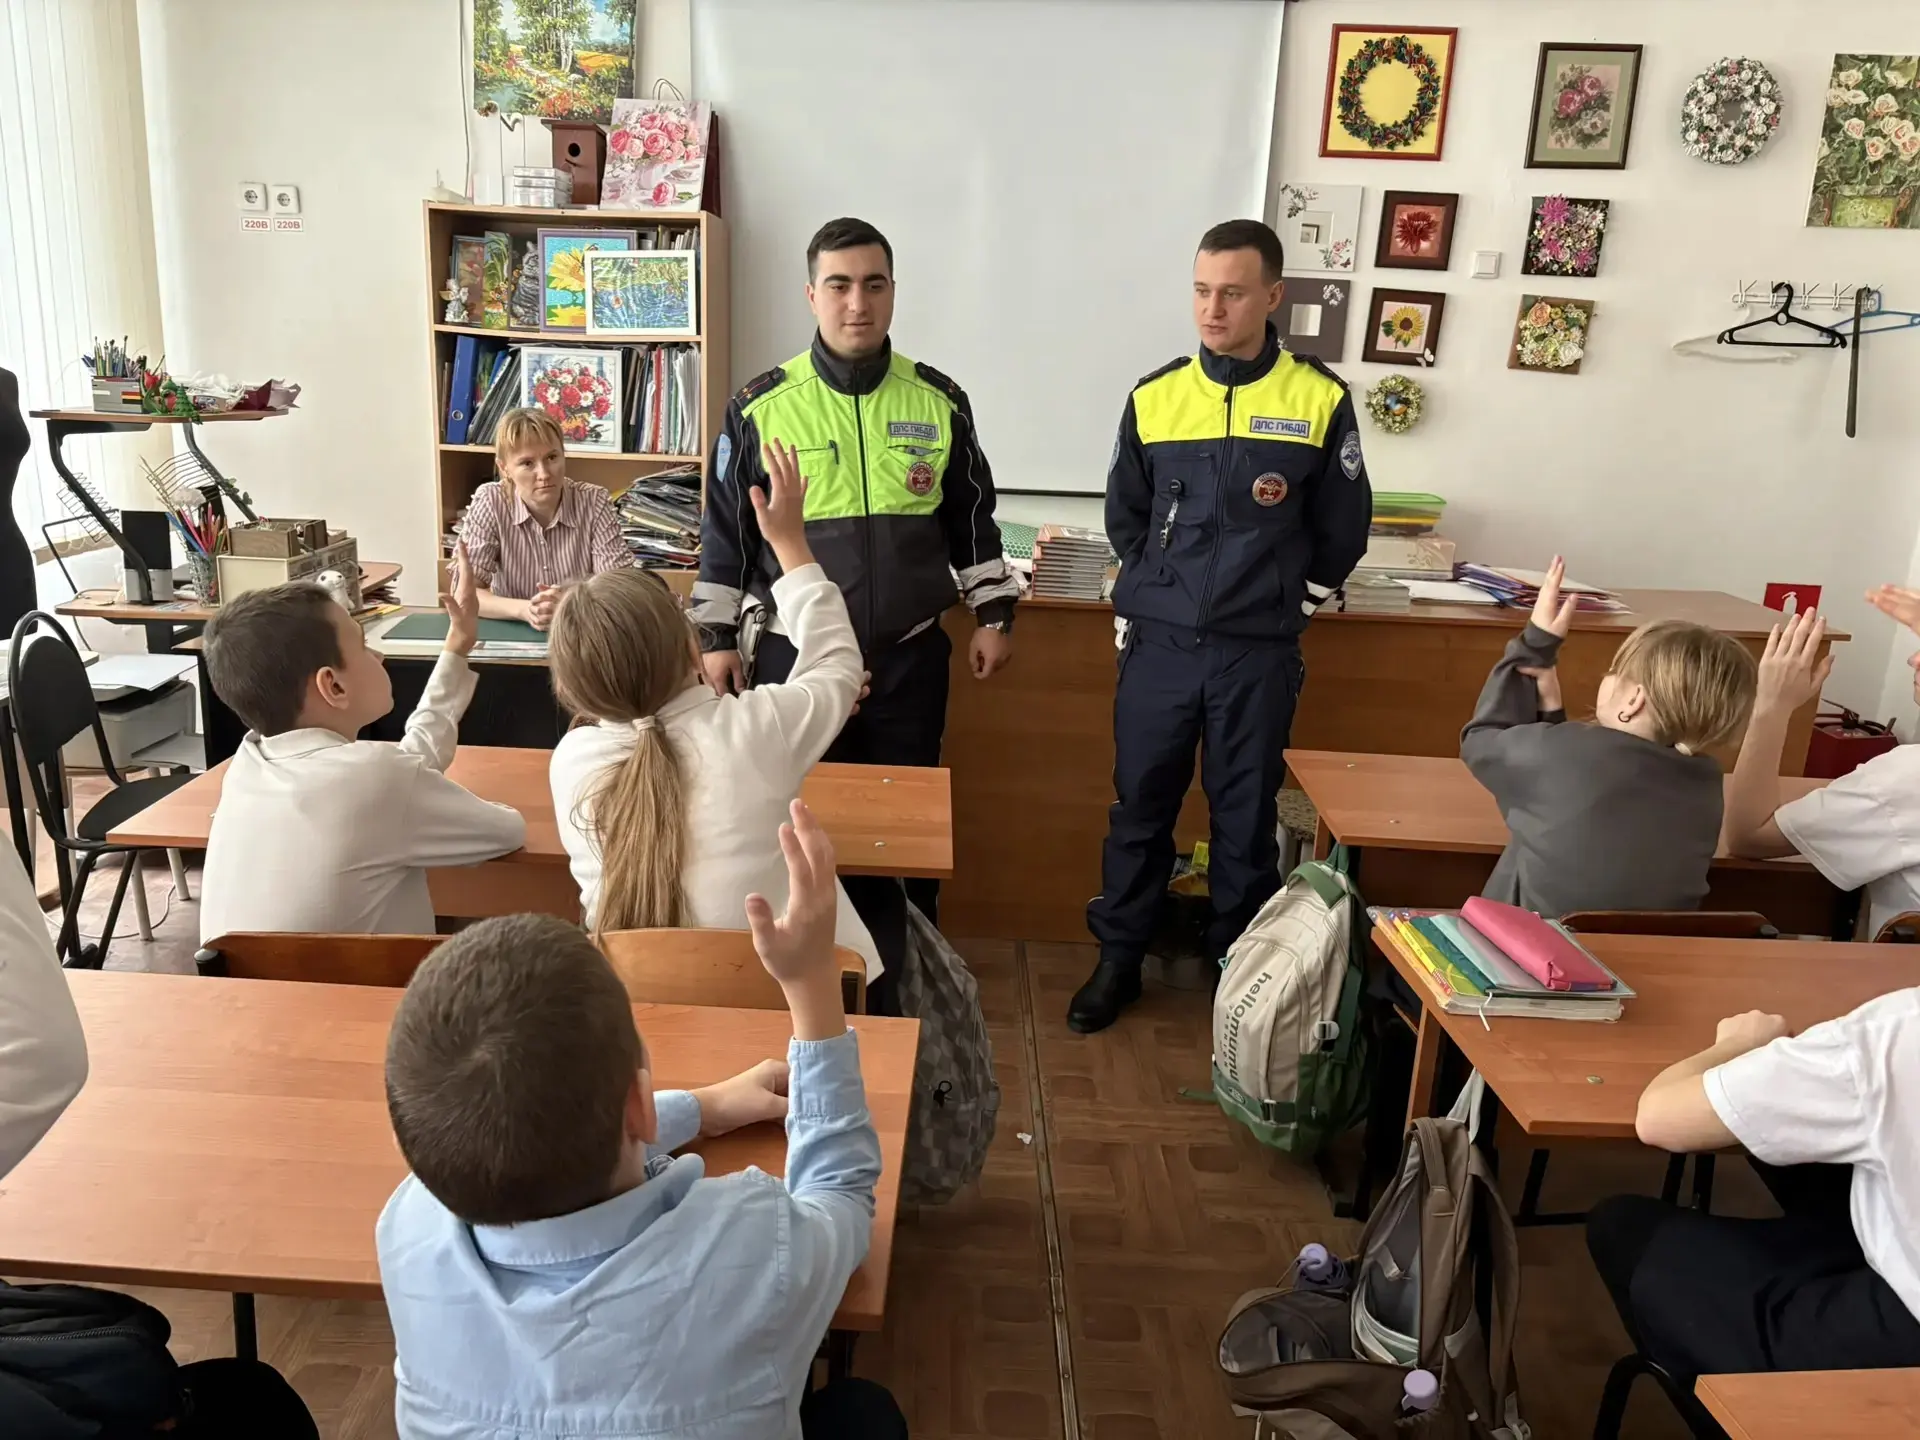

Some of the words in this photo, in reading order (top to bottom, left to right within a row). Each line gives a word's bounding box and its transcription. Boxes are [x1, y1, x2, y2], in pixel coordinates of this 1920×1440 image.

[893, 425, 909, 433] ДПС
[910, 426, 933, 436] ГИБДД
[1253, 420, 1274, 429] ДПС
[1276, 421, 1307, 434] ГИБДД
[1228, 972, 1272, 1081] hellomumu
